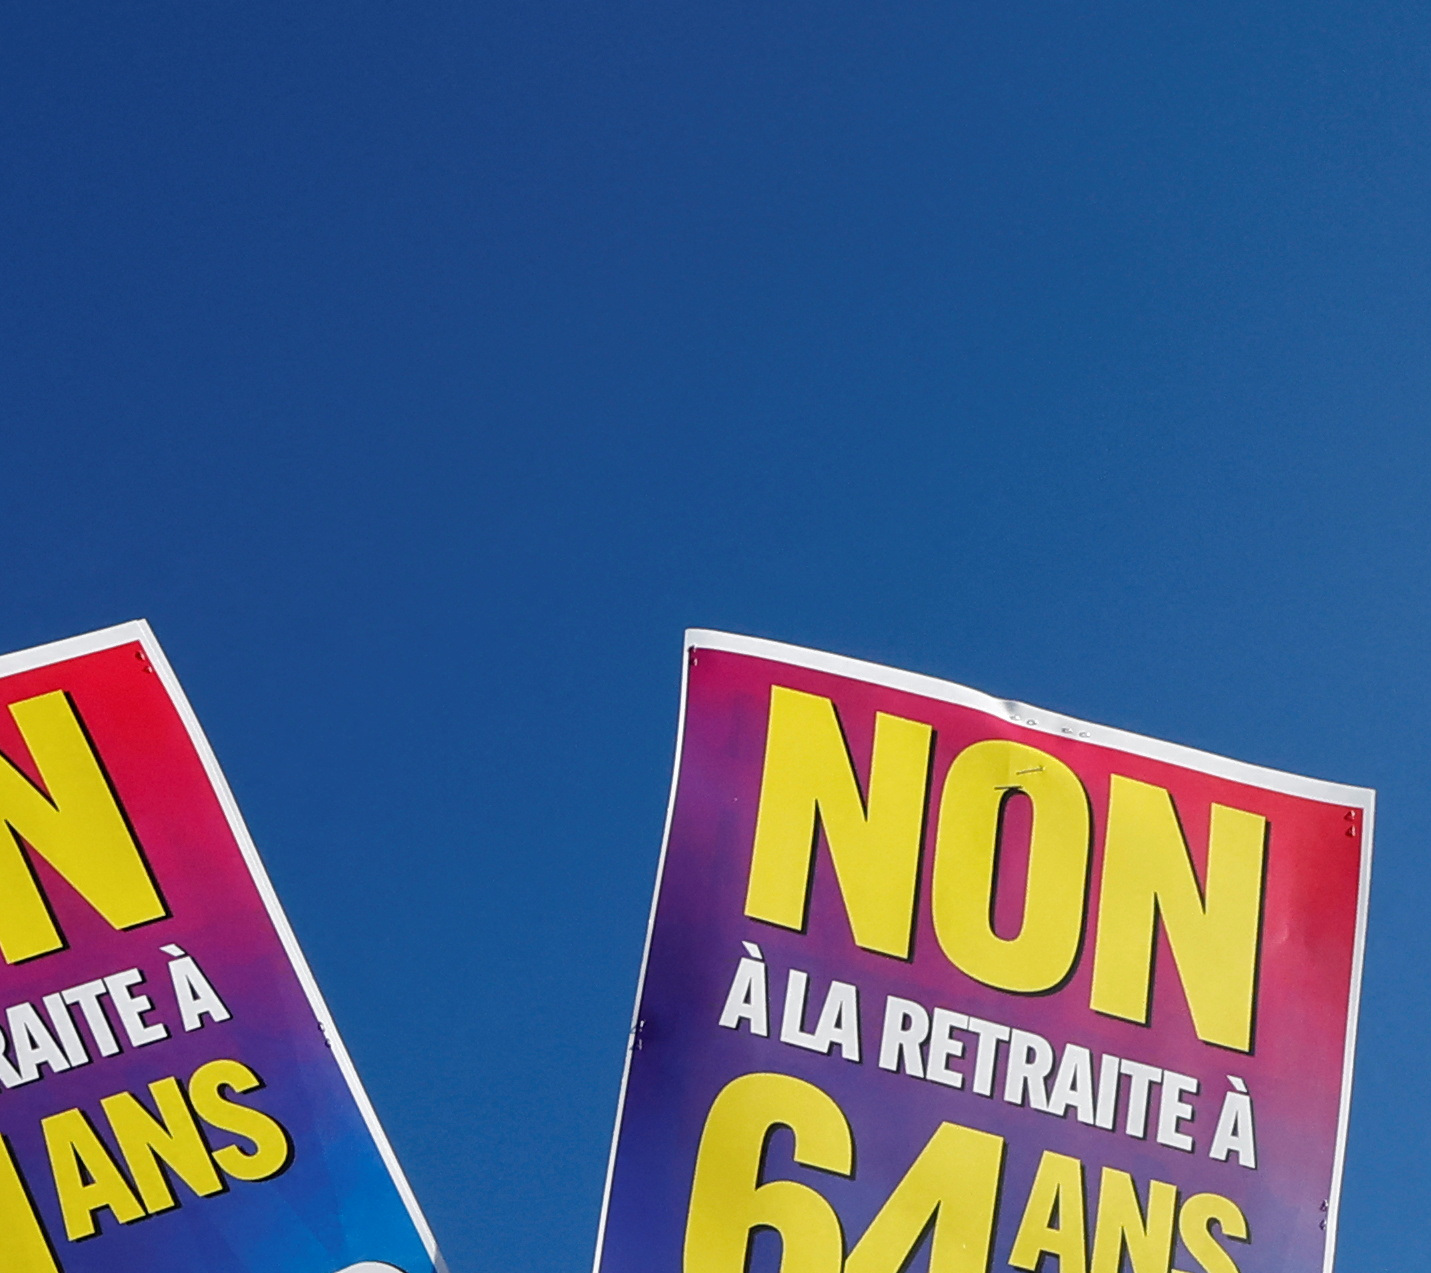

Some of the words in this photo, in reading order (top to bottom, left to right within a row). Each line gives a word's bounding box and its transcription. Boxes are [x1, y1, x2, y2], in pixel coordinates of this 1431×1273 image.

[744, 684, 1269, 1054] NON
[161, 945, 231, 1031] À
[720, 942, 767, 1036] À
[781, 993, 861, 1063] LA
[878, 1010, 1199, 1151] RETRAITE
[1212, 1076, 1256, 1169] À
[42, 1059, 292, 1243] ANS
